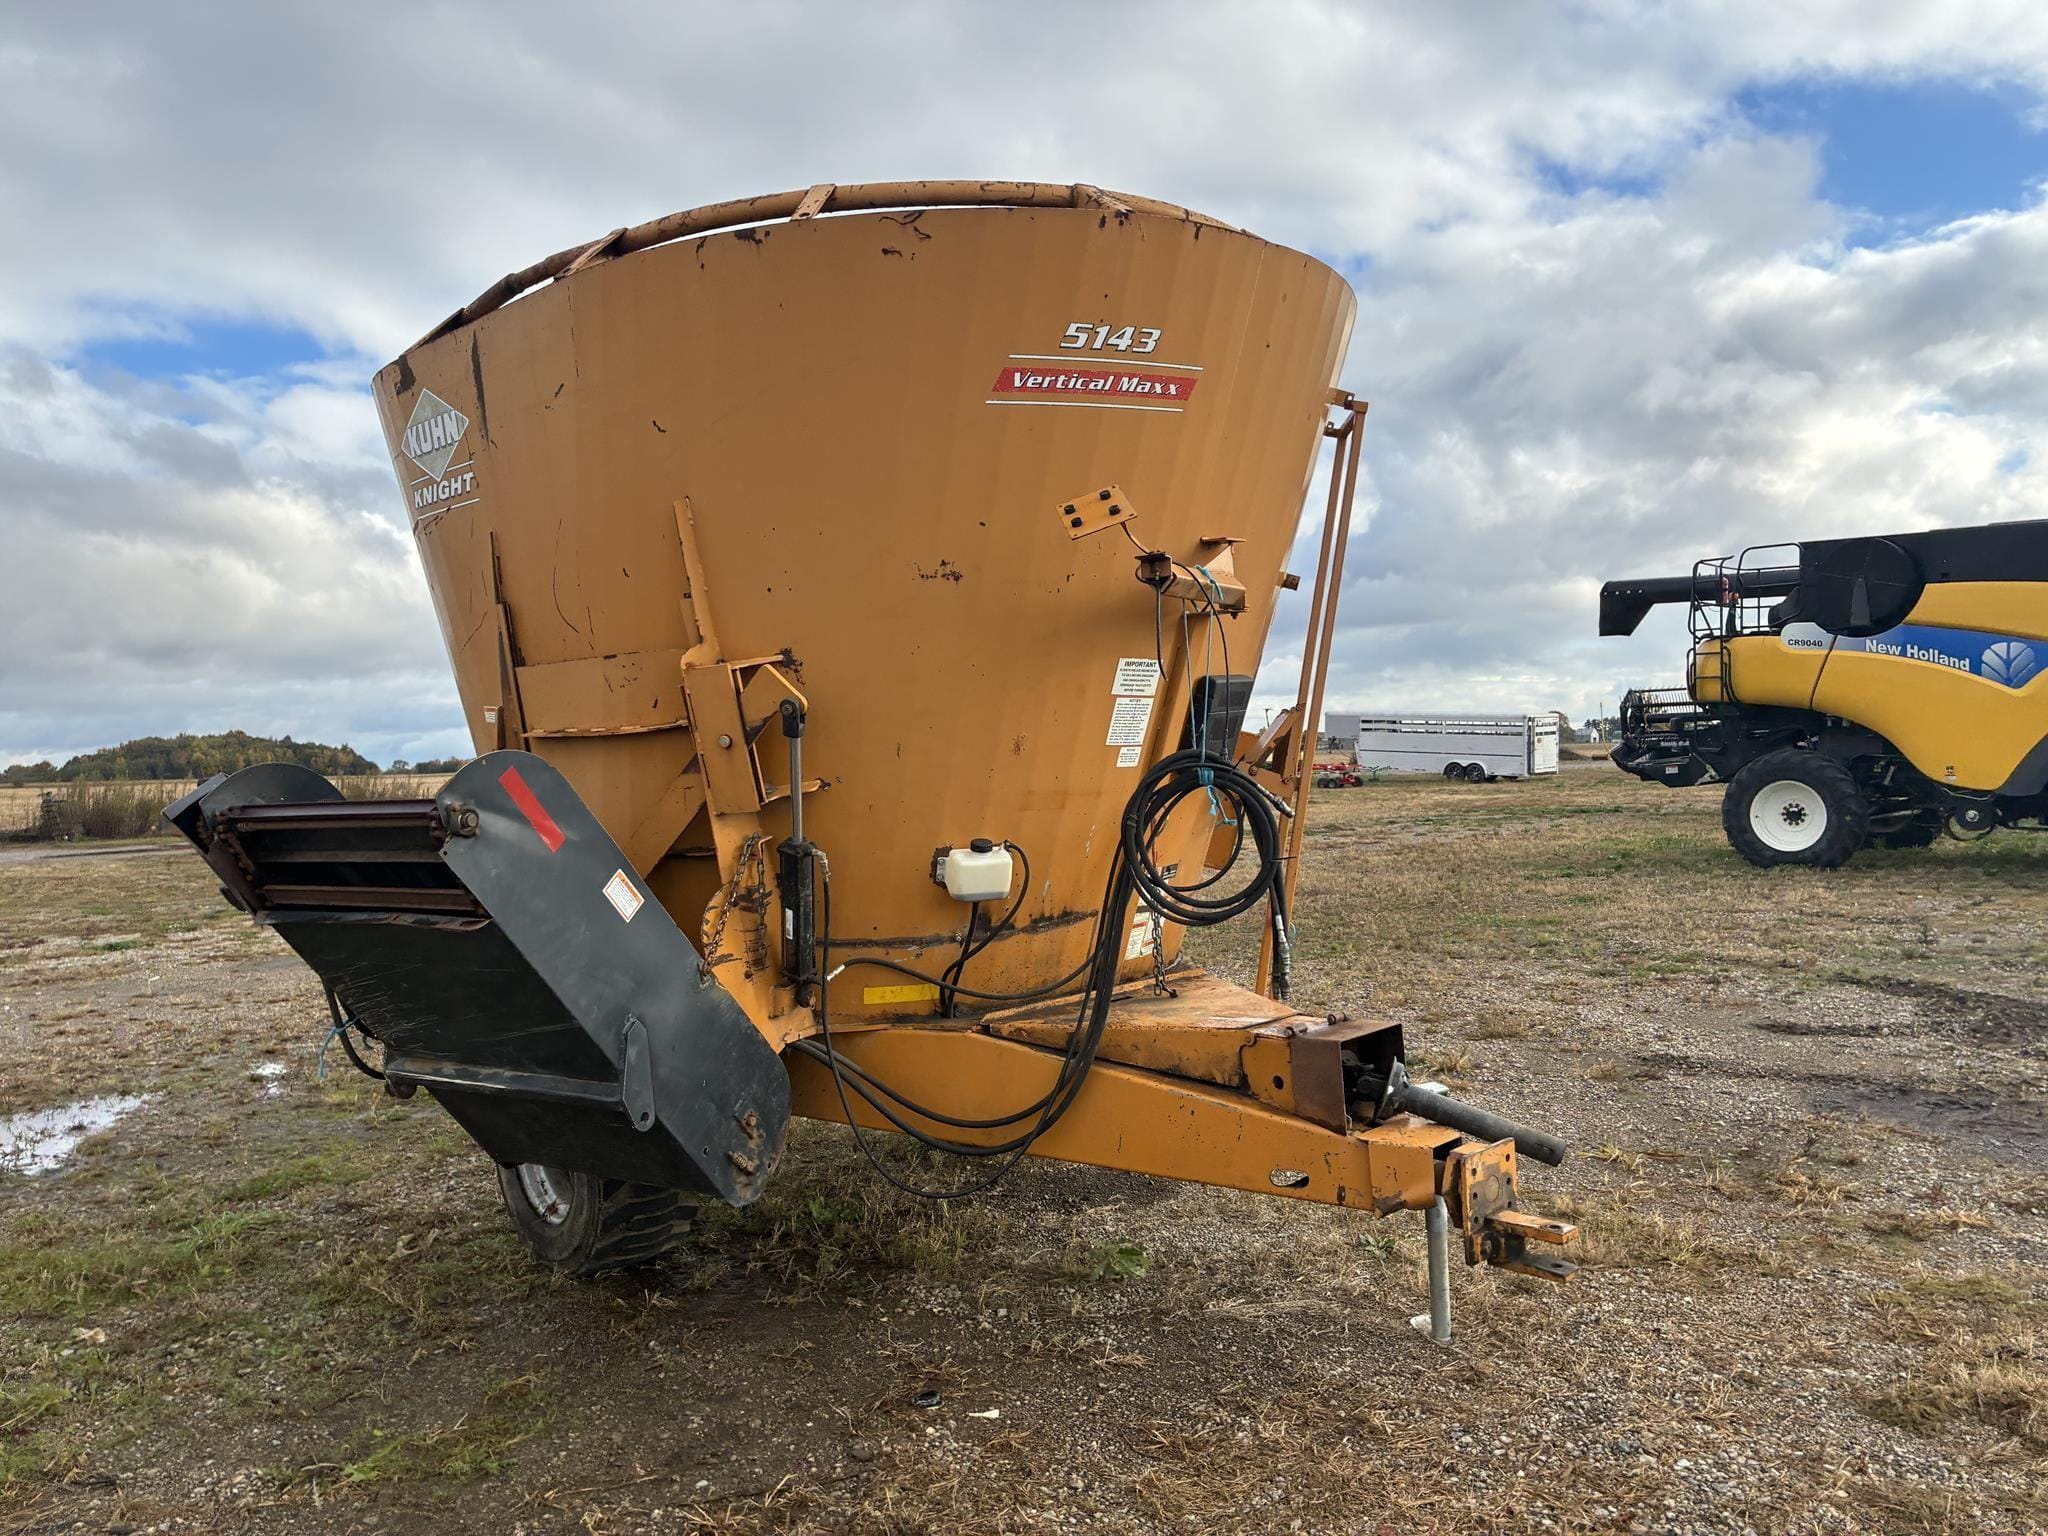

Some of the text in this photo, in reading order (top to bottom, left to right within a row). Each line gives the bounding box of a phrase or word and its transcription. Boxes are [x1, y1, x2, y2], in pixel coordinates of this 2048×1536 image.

[1059, 321, 1162, 354] 5143
[1012, 370, 1181, 396] Vertical Maxx
[406, 410, 460, 458] KUHN
[414, 471, 475, 509] KNIGHT
[1787, 638, 1823, 647] CR9040
[1865, 638, 1970, 671] New Holland
